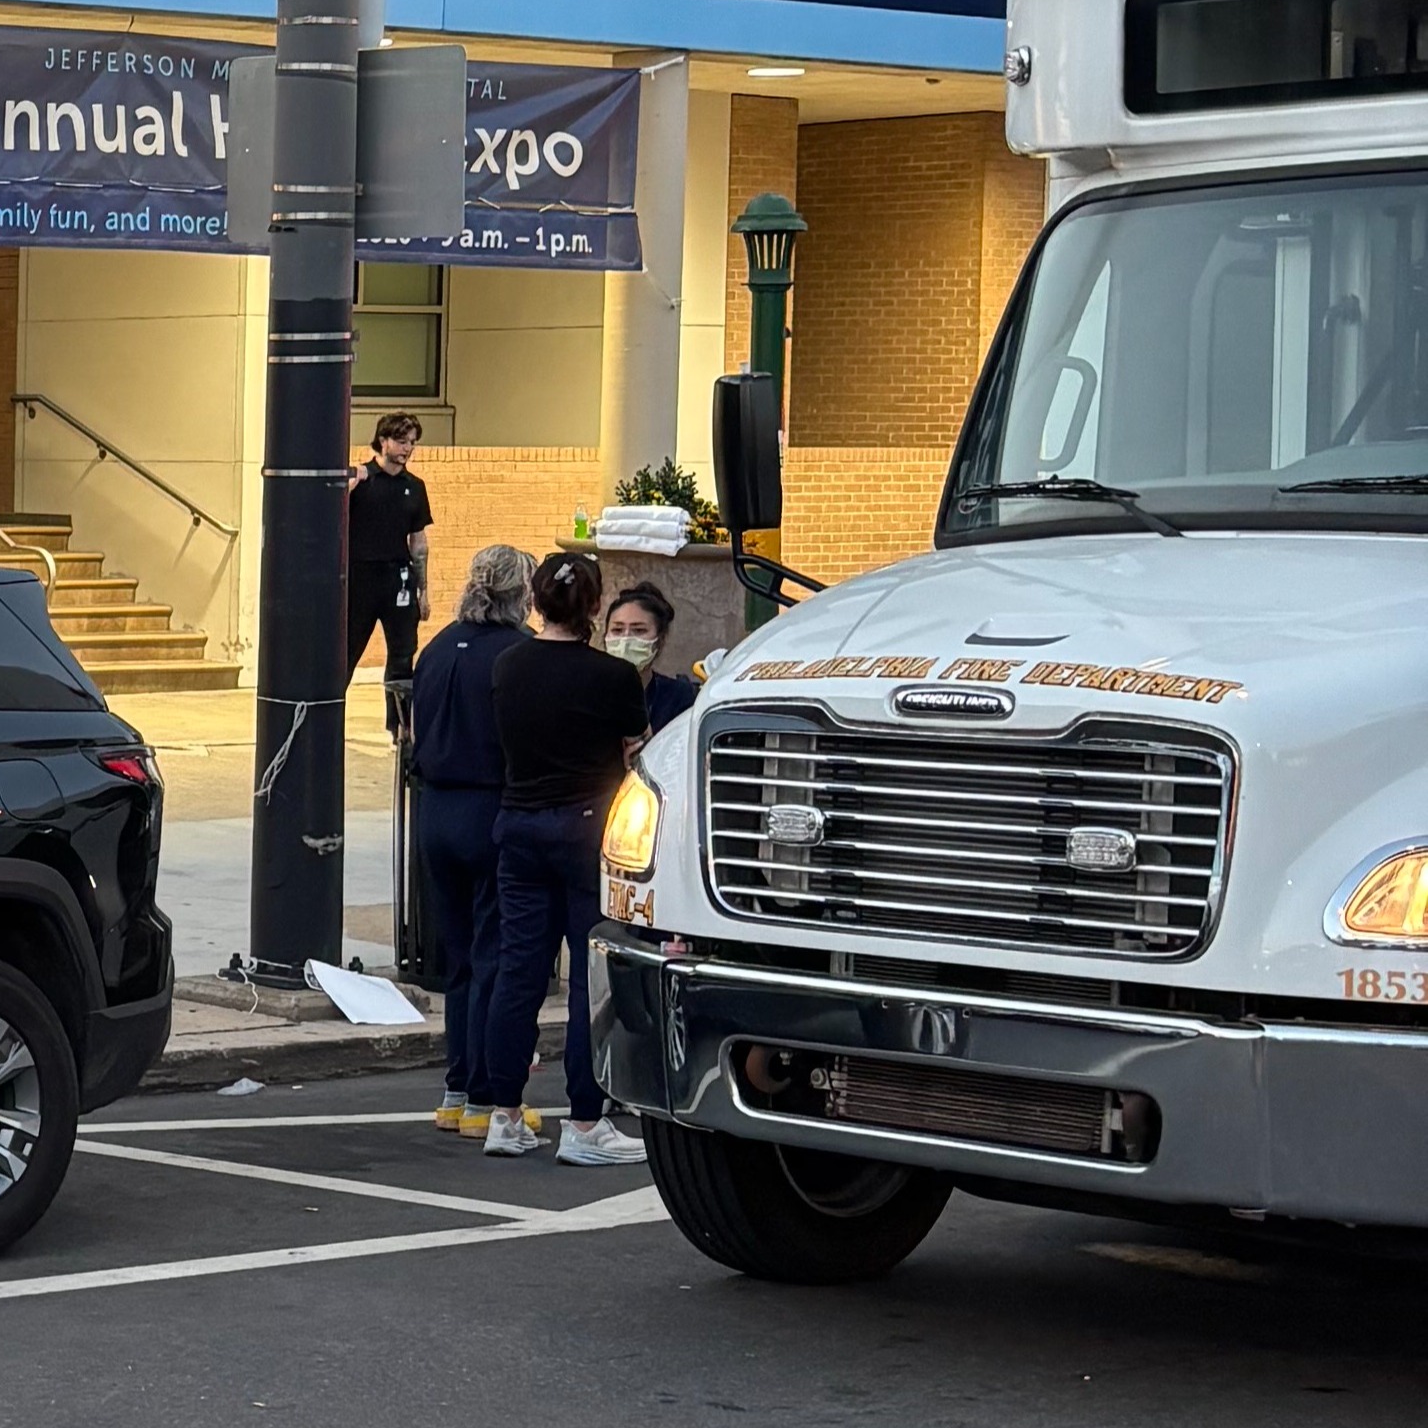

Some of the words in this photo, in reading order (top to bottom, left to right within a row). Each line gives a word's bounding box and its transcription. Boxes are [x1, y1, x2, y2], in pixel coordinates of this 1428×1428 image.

[45, 47, 195, 79] JEFFERSON
[464, 127, 584, 191] xpo
[49, 203, 95, 233] fun,
[105, 207, 151, 232] and
[159, 210, 229, 236] more!
[459, 227, 509, 250] a.m.
[734, 655, 940, 683] PHILADELPHIA
[937, 656, 1027, 683] FIRE
[1019, 660, 1243, 704] DEPARTMENT
